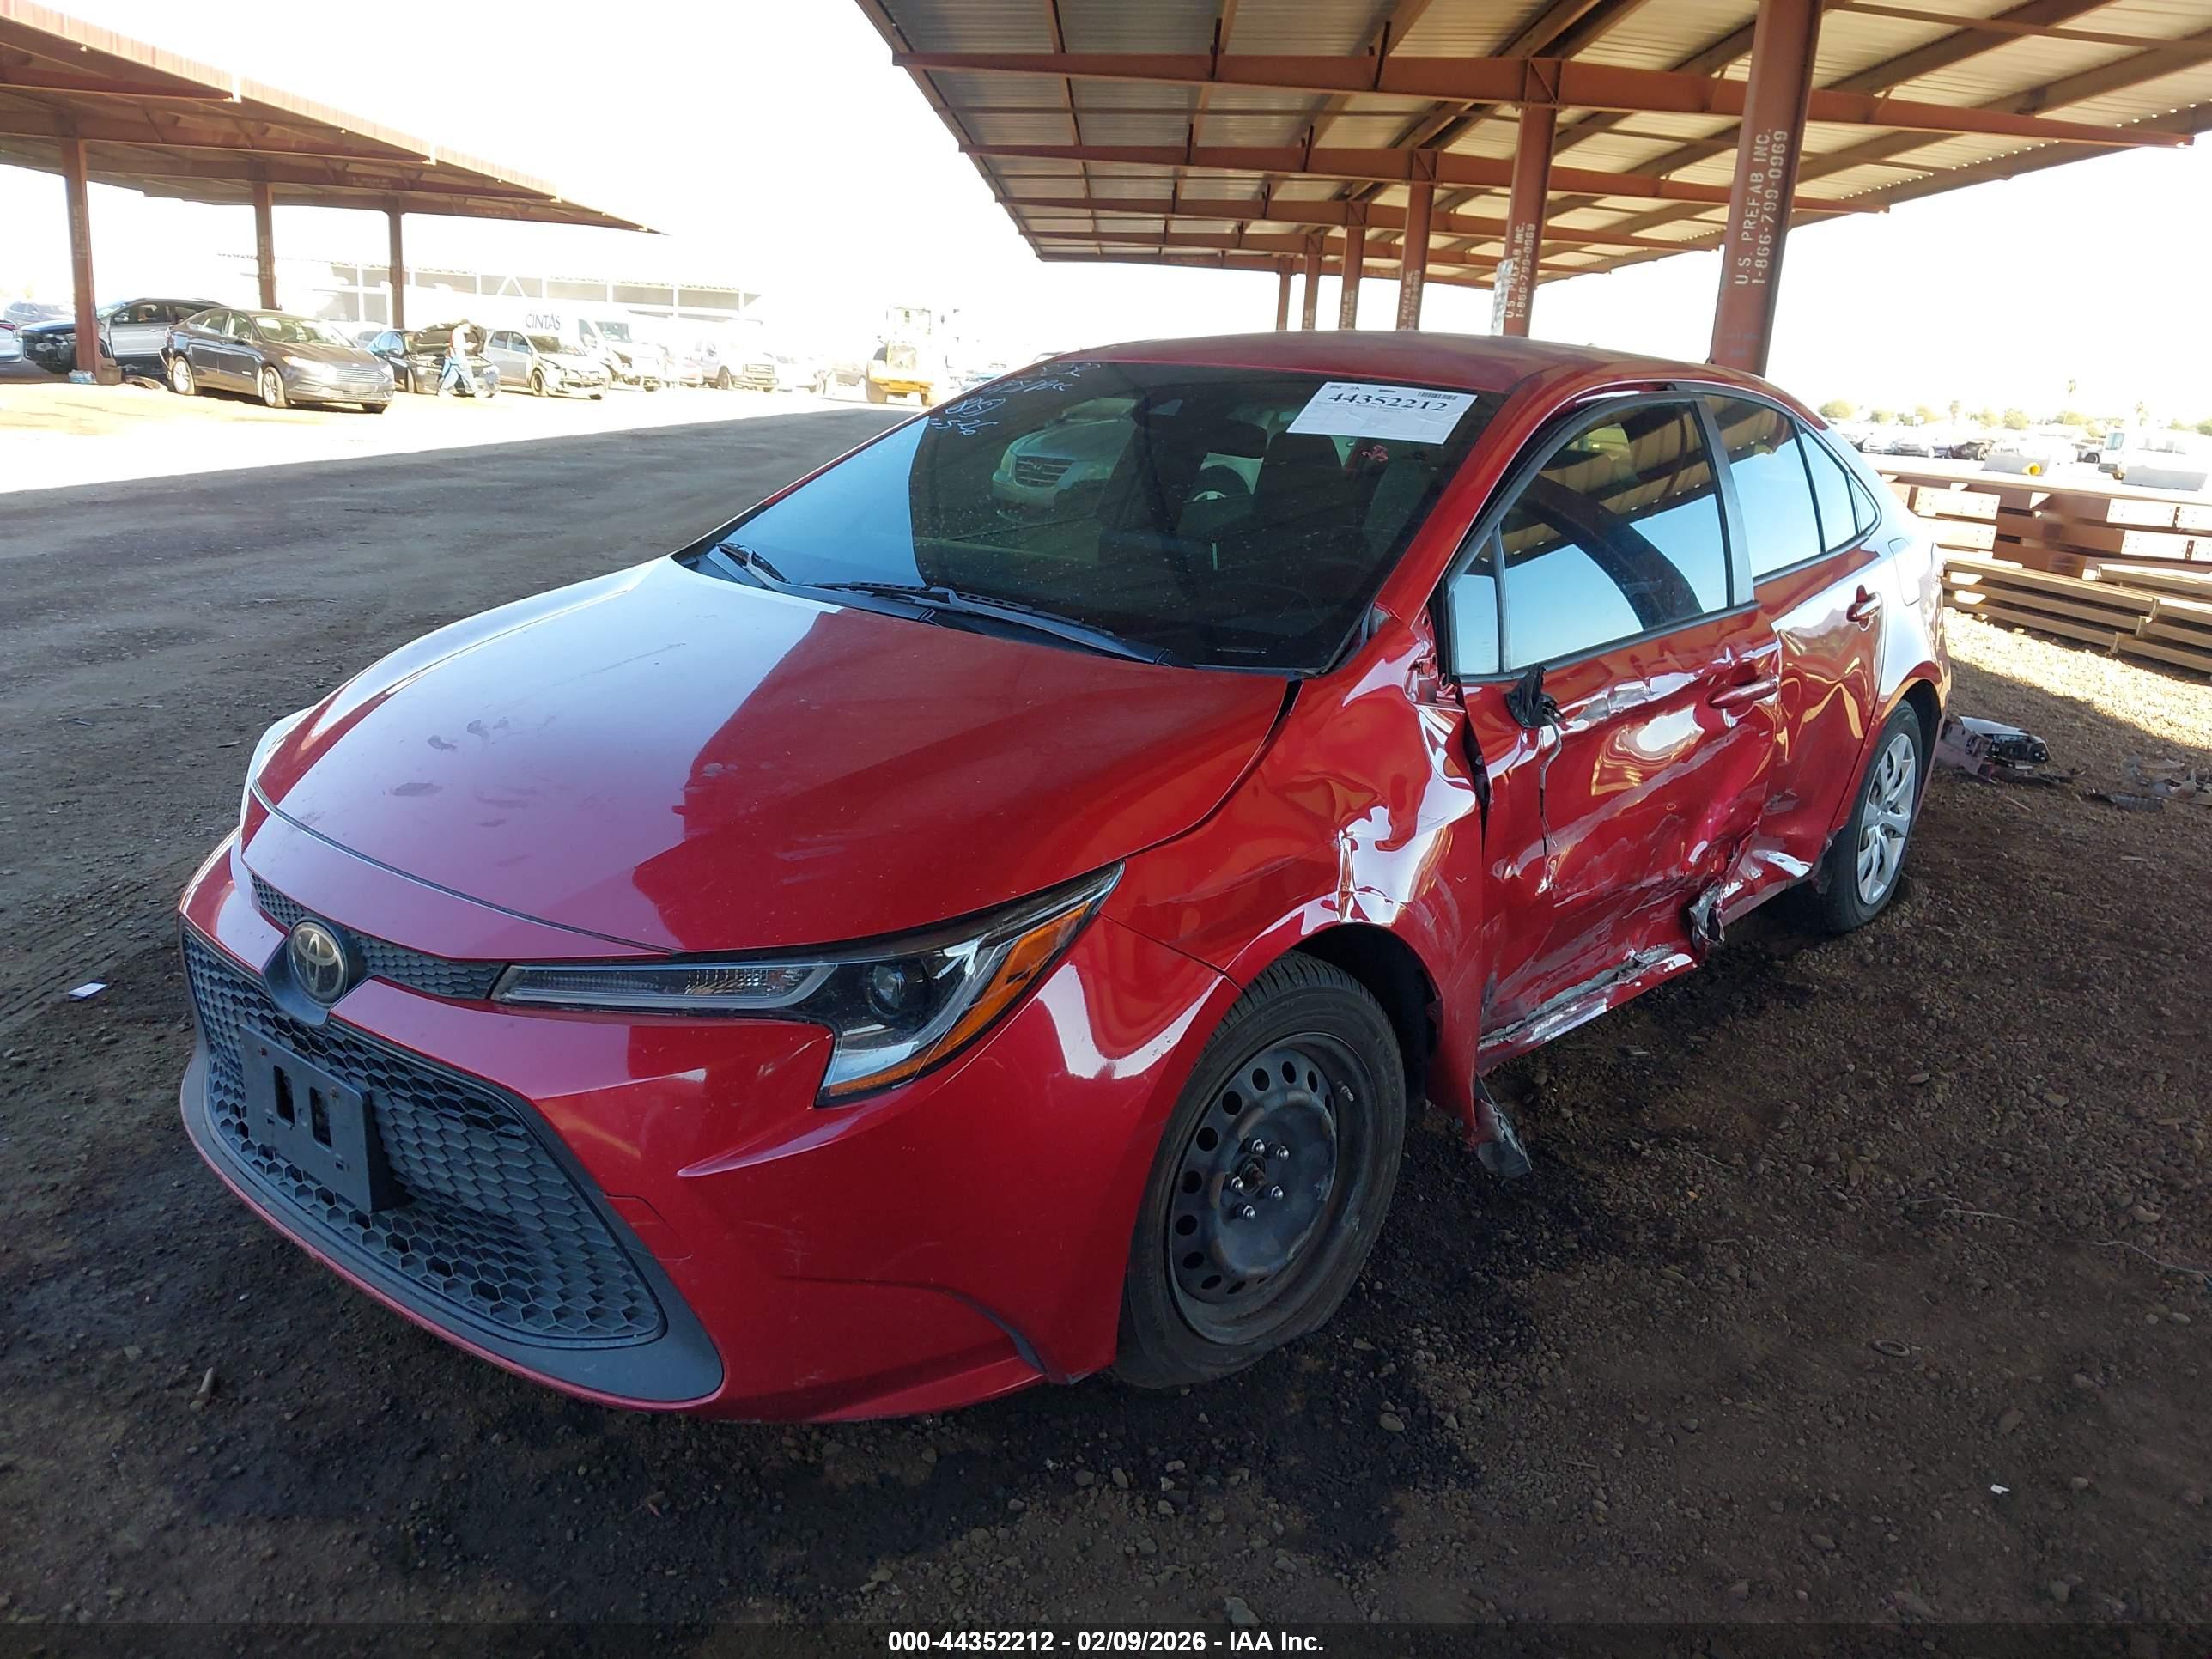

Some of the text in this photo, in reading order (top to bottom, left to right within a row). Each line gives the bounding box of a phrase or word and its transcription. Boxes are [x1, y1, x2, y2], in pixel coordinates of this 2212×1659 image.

[1734, 128, 1771, 285] U.S. PREFAB INC.
[1751, 130, 1789, 284] 1-866-799-0969
[525, 313, 561, 331] CINTAS
[1328, 392, 1448, 411] 44352212
